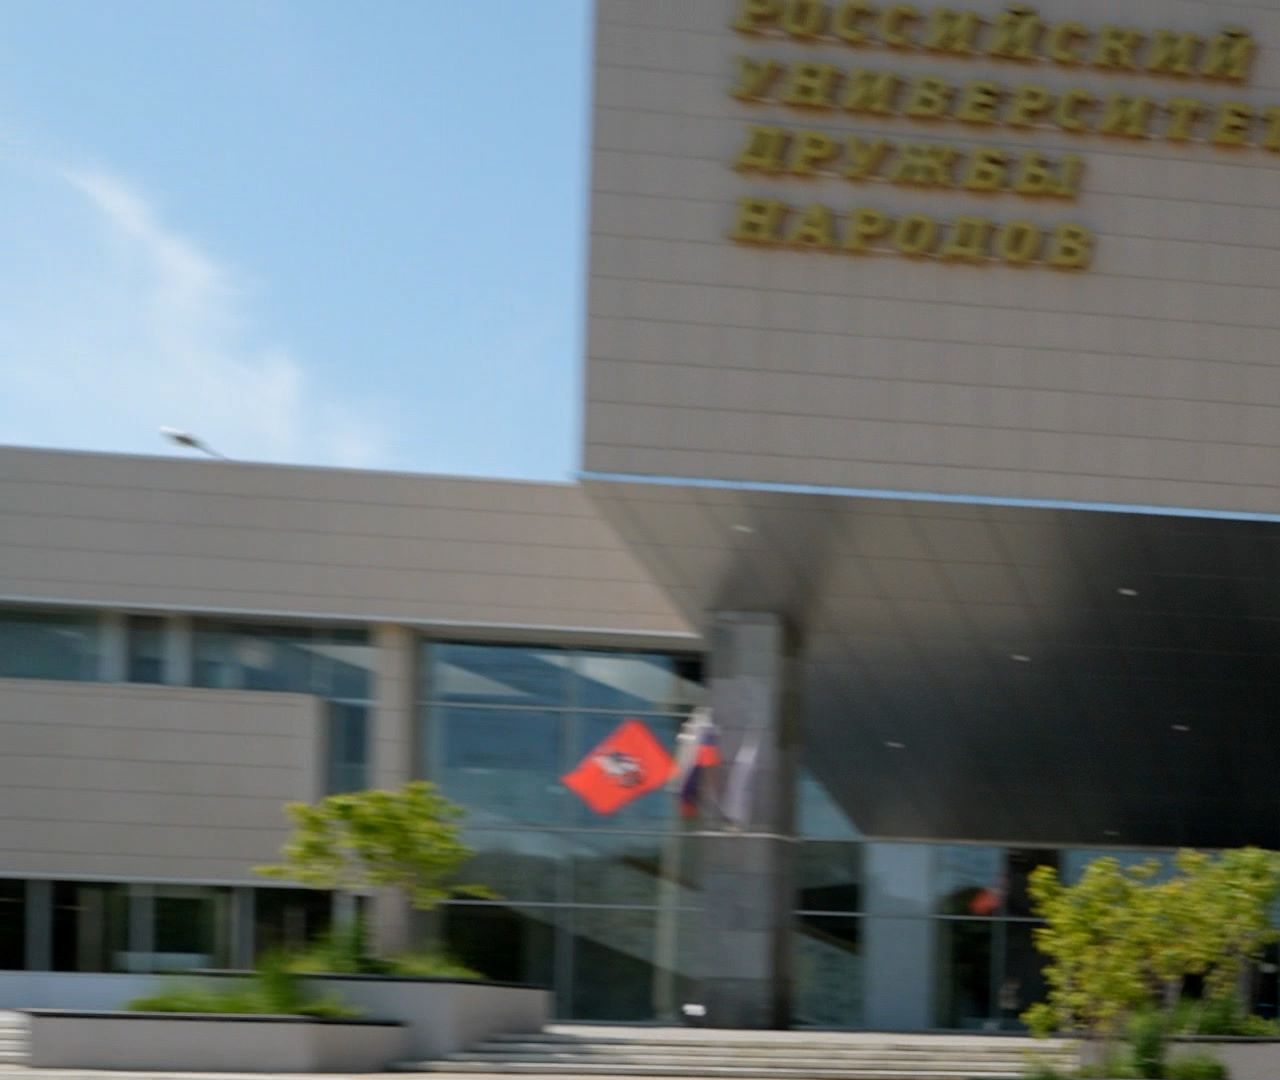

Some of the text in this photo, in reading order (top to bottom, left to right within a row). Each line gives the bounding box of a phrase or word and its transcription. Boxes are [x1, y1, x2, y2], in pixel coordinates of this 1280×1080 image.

[730, 0, 1258, 84] РОССИЙСКИЙ
[733, 124, 1088, 201] ДРУЖБЫ
[730, 197, 1093, 269] НАРОДОВ
